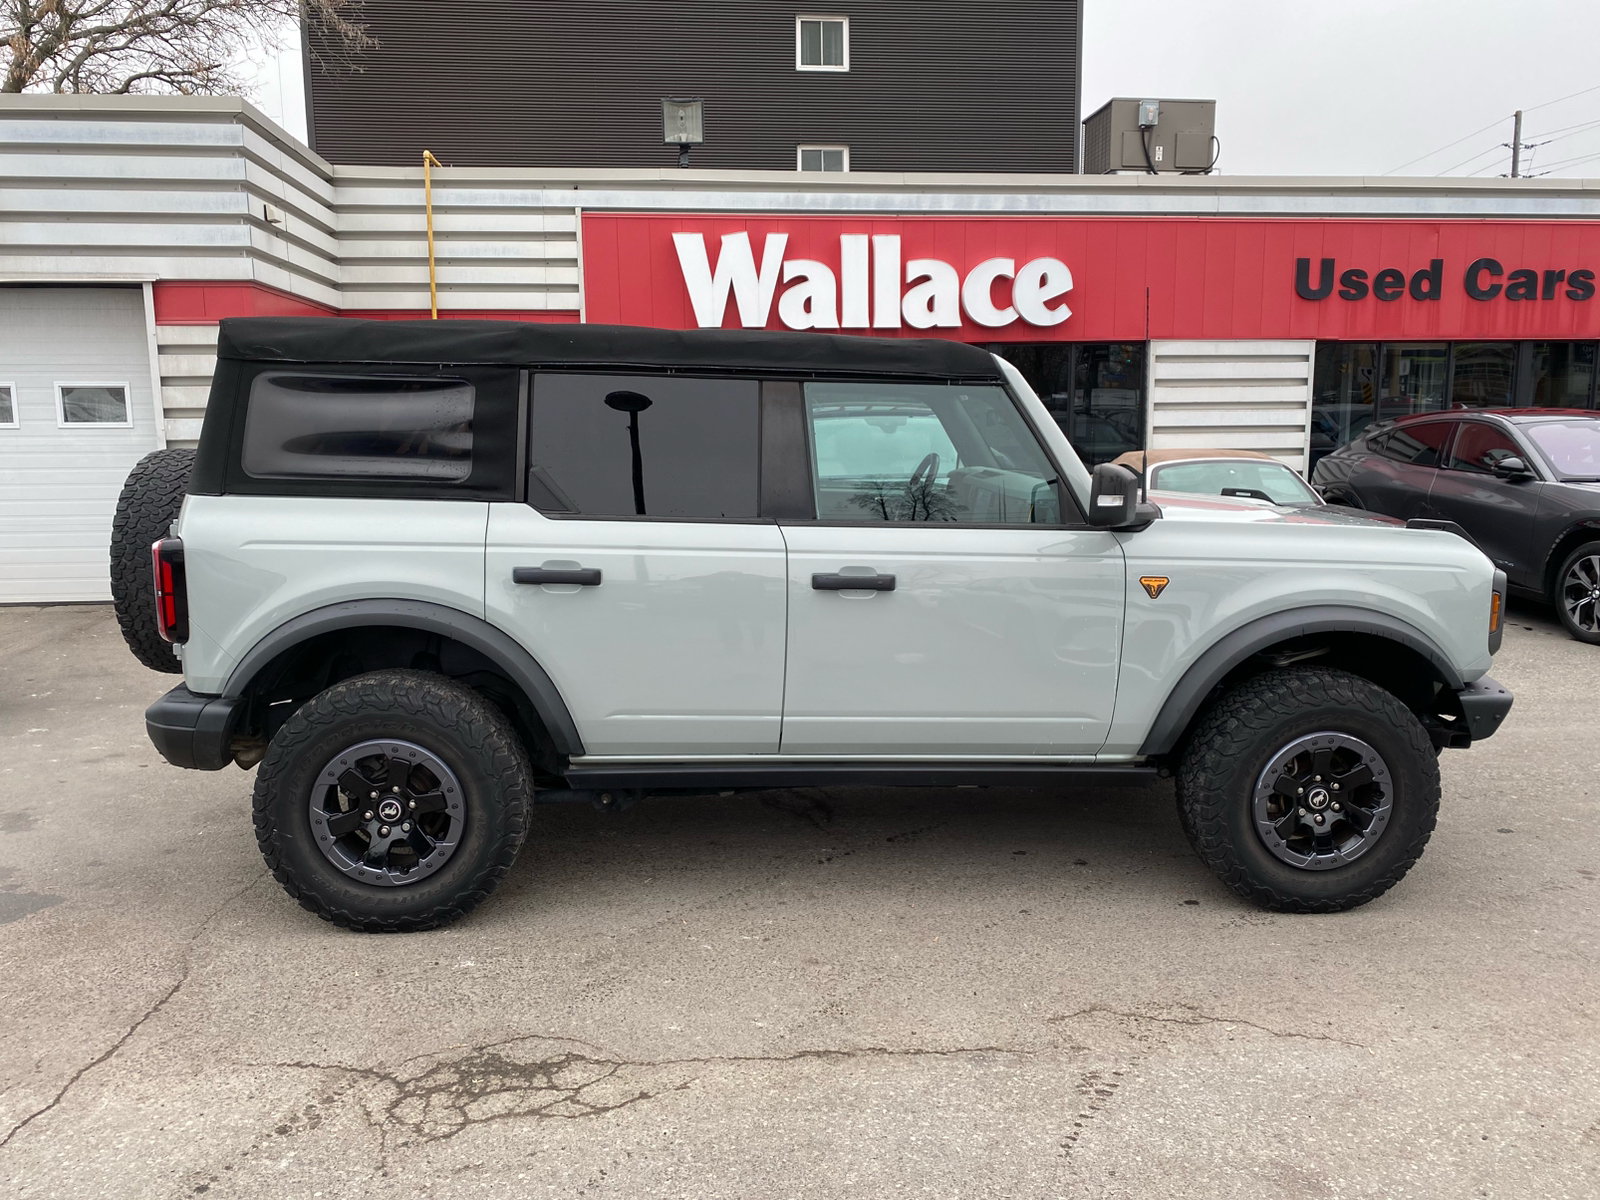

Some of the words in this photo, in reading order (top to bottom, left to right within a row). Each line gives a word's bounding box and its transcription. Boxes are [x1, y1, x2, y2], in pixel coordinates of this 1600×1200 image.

[671, 231, 1074, 330] Wallace
[1295, 257, 1444, 301] Used
[1464, 257, 1596, 301] Cars
